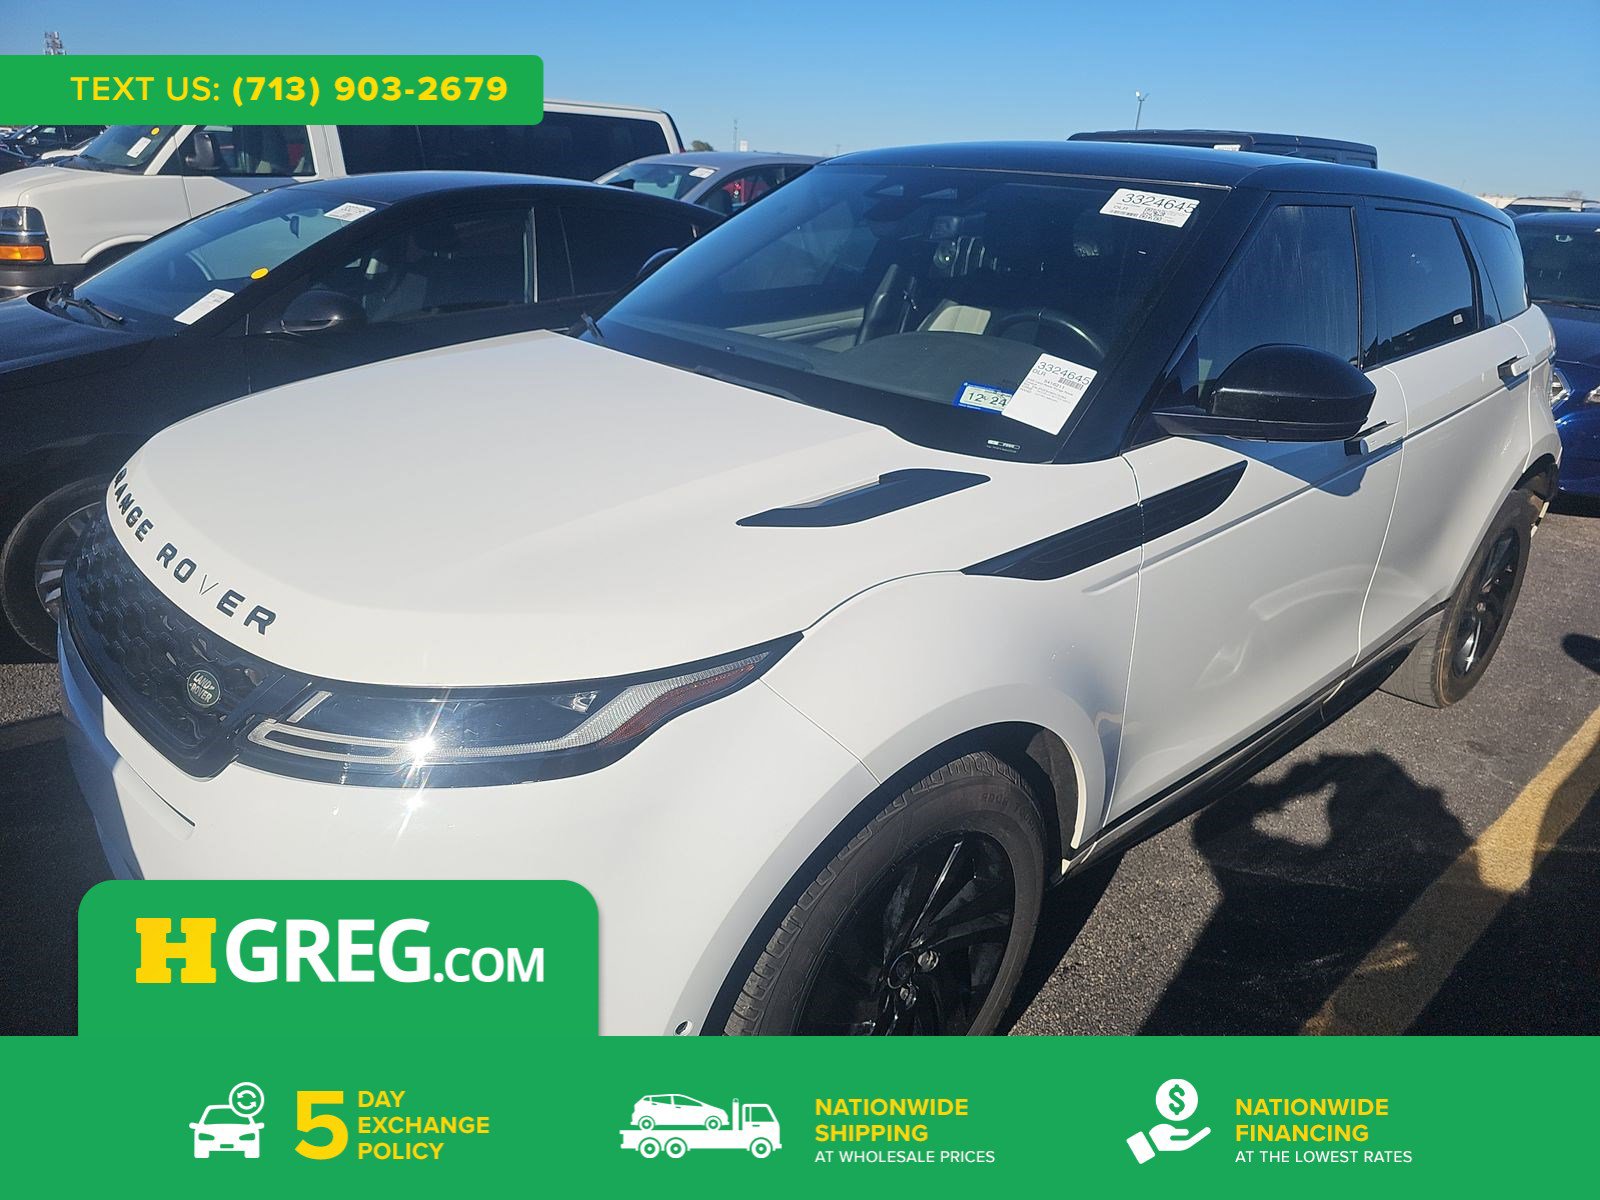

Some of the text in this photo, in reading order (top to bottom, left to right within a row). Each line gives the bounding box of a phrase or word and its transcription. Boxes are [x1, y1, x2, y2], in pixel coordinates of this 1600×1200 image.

[1122, 193, 1197, 213] 3324645
[1038, 362, 1091, 385] 3324645
[969, 392, 1007, 406] 12 24
[114, 468, 277, 635] RANGE ROVER
[193, 673, 211, 689] LAND
[191, 682, 213, 702] ROVER
